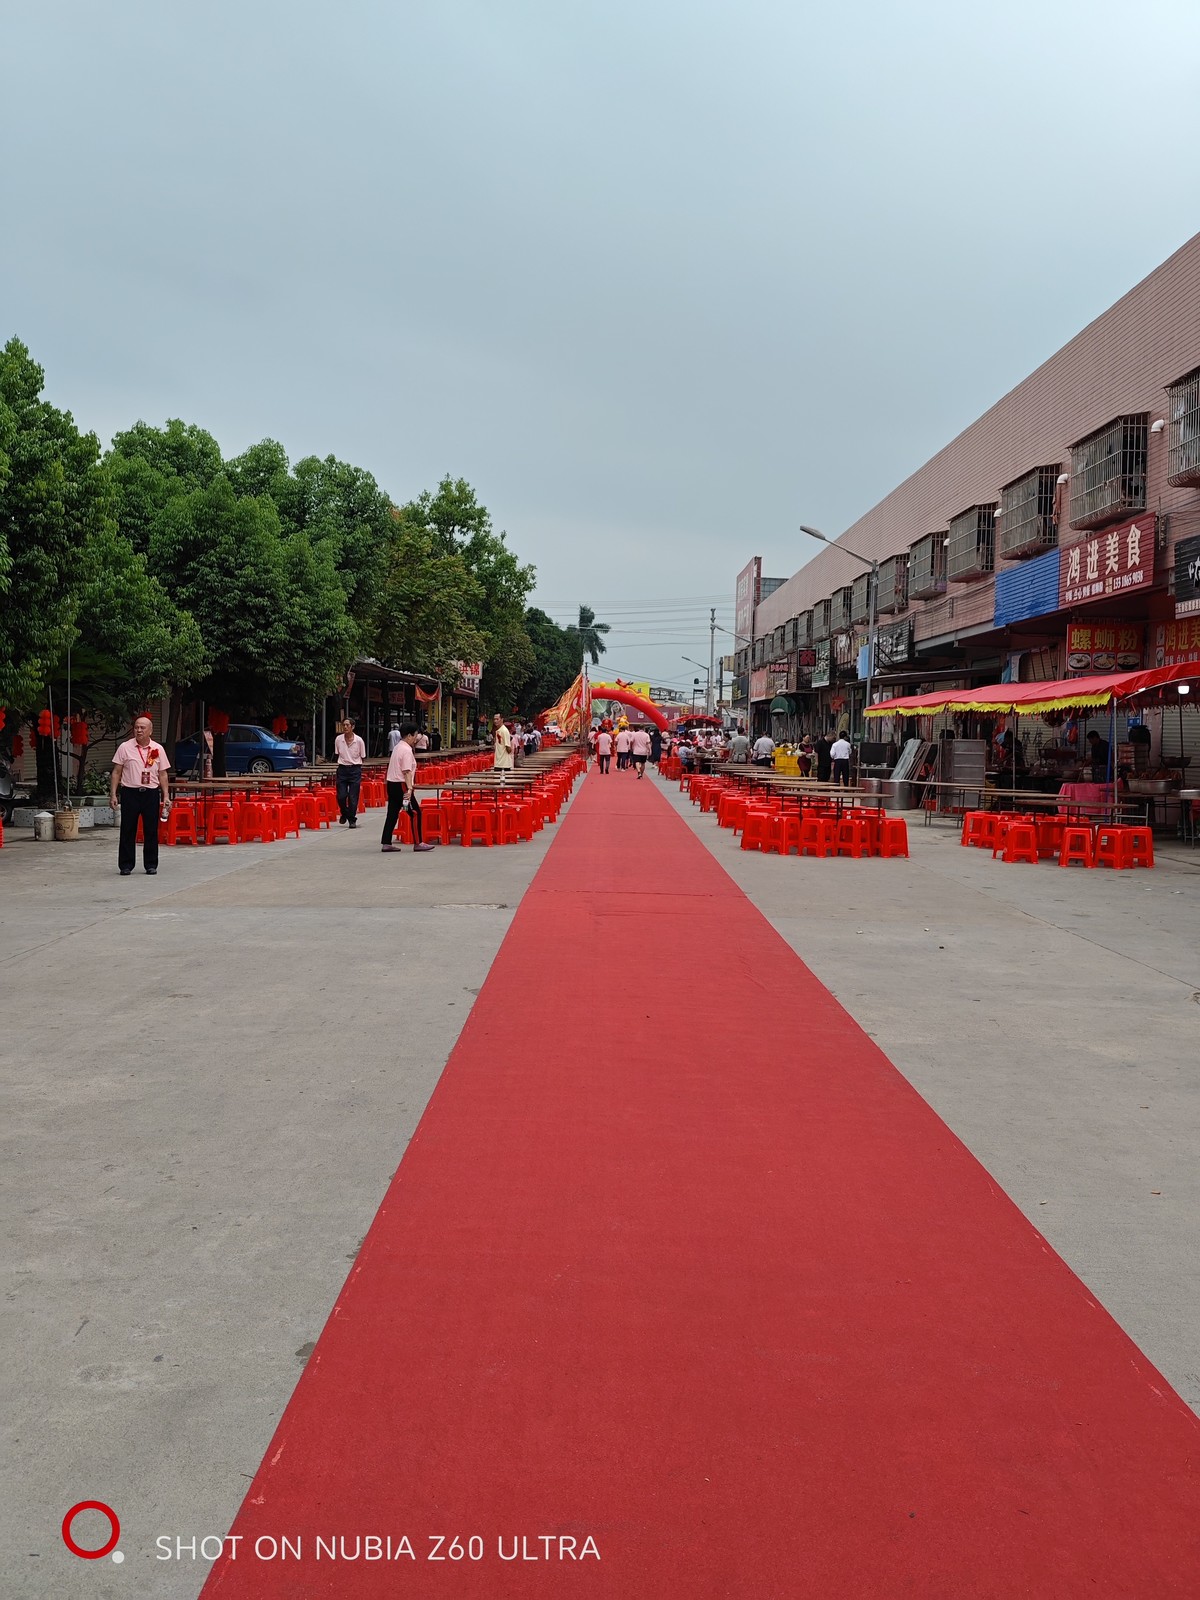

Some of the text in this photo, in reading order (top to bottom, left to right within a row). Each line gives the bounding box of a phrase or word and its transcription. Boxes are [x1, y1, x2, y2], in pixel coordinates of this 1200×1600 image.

[1066, 523, 1141, 588] 鸿进美食
[1071, 628, 1138, 651] 螺蛳粉
